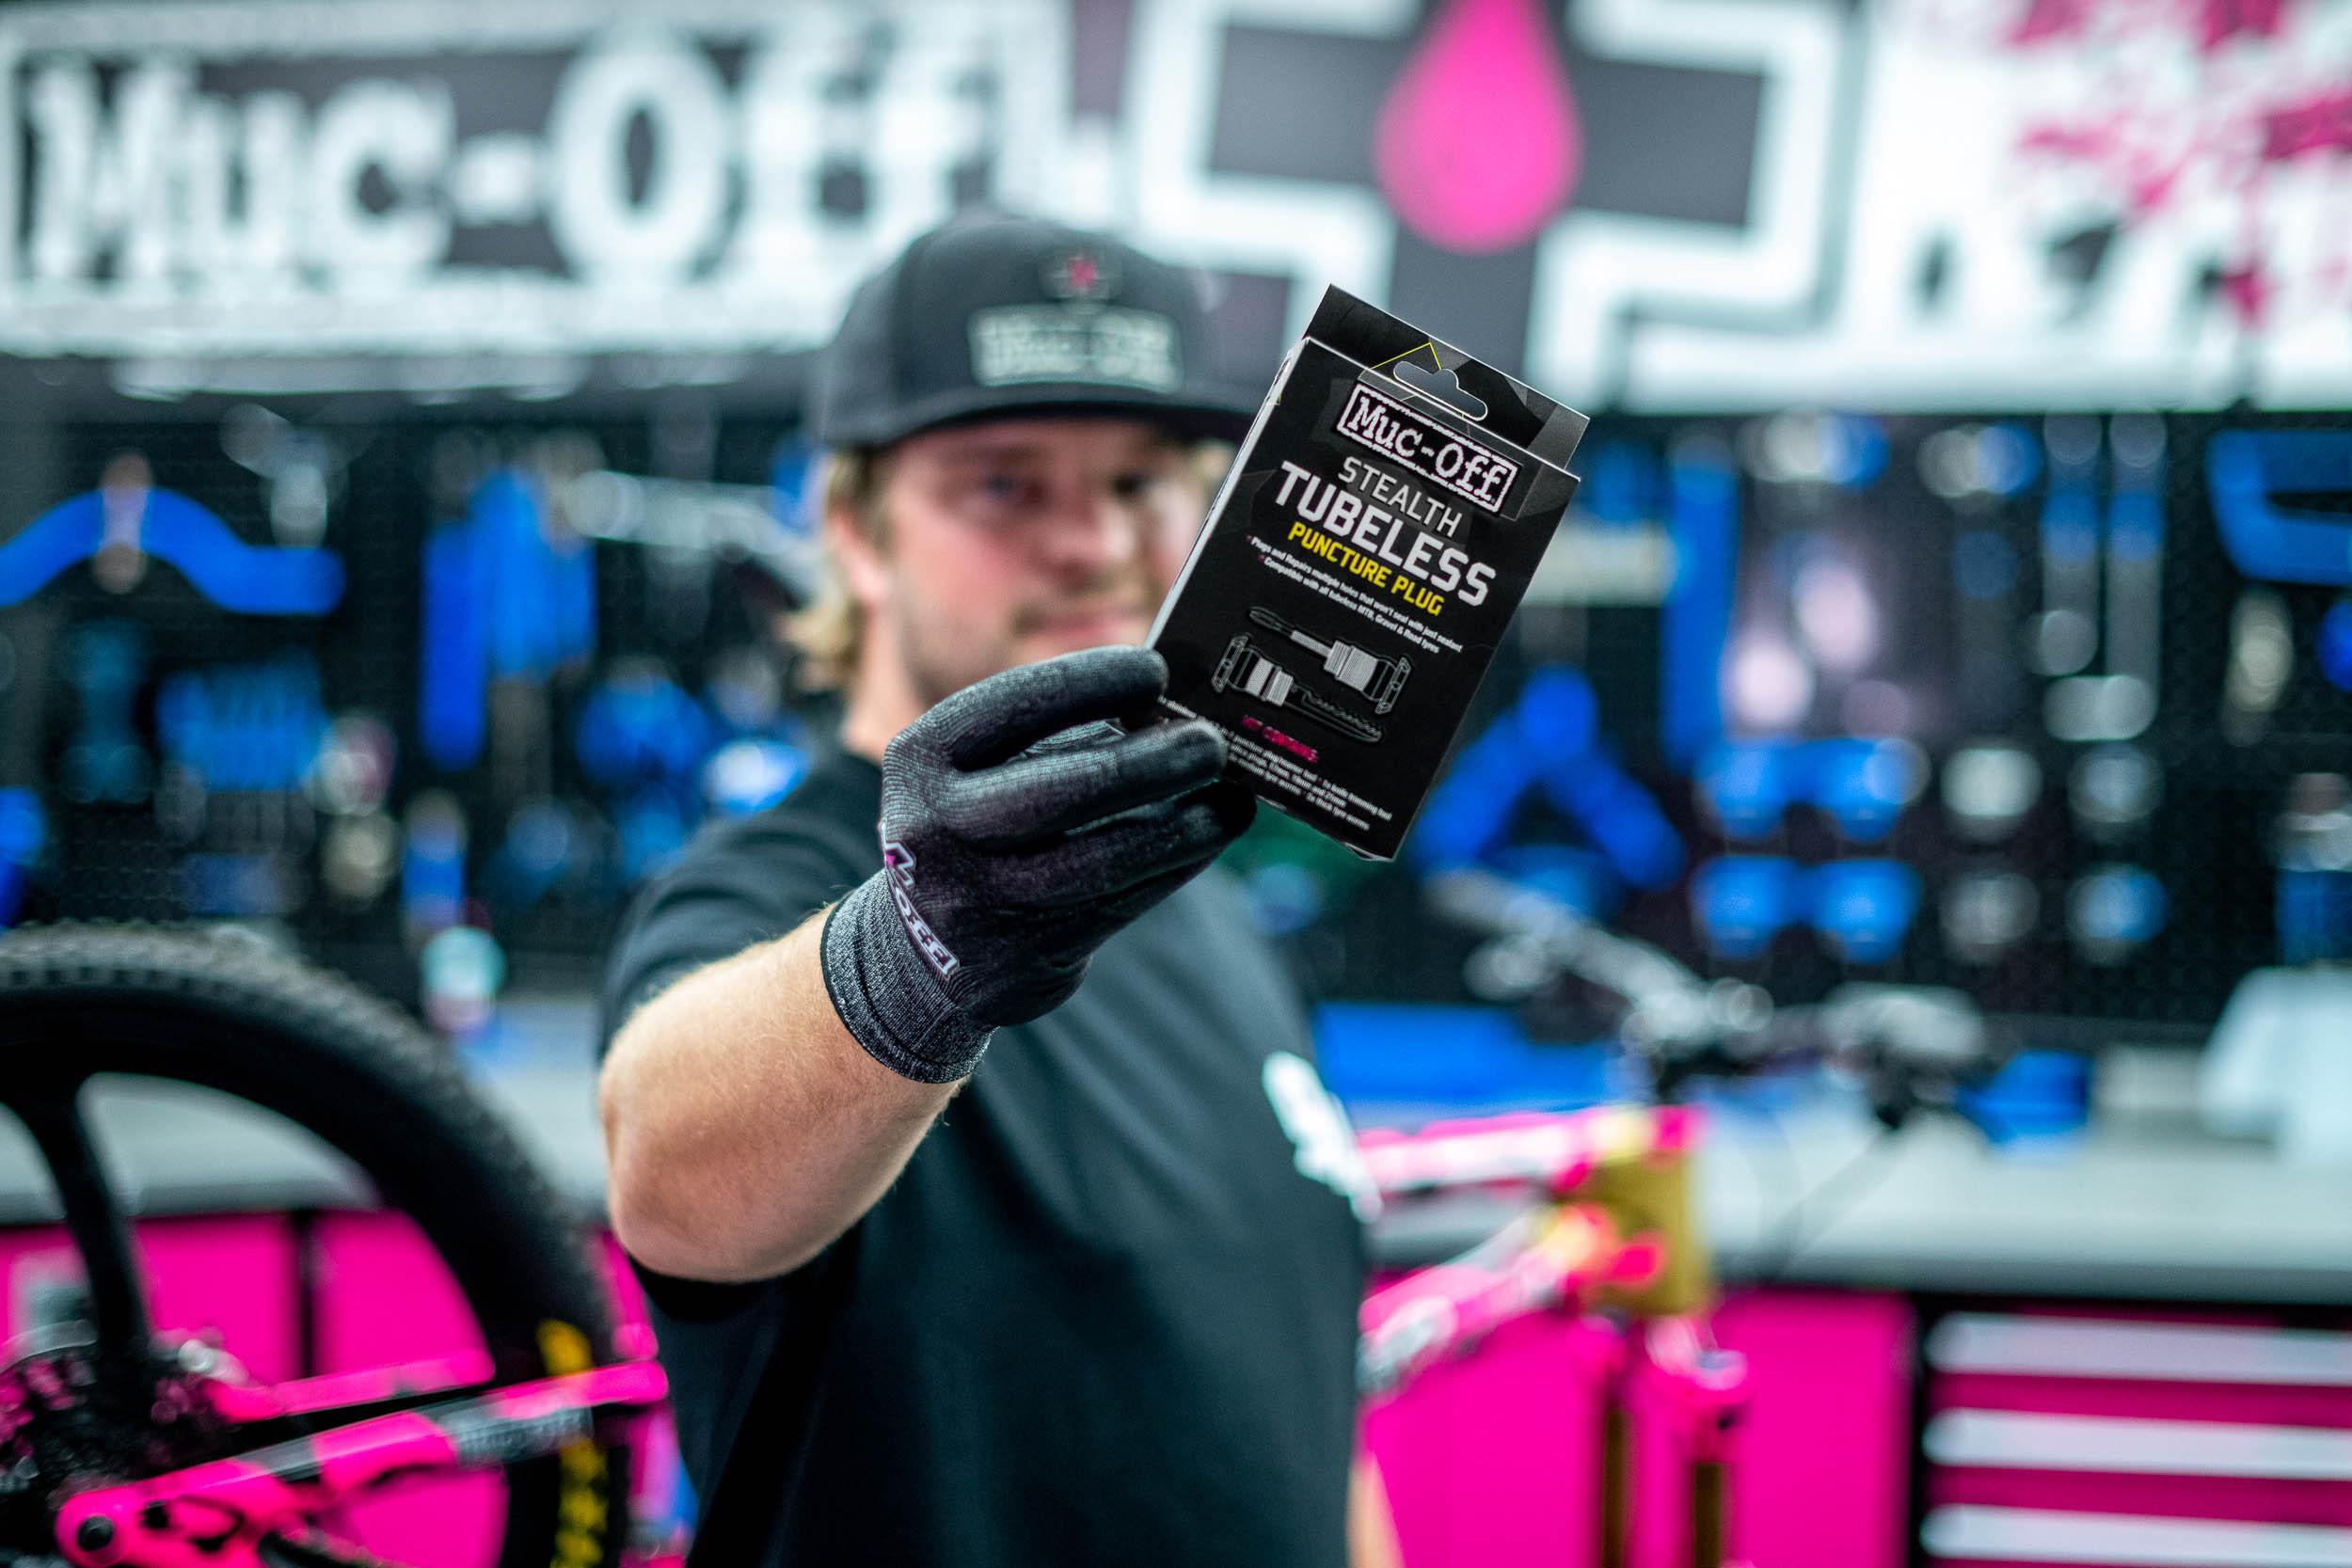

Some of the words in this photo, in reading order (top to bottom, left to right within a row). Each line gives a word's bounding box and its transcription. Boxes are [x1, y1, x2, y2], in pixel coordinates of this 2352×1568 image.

[1339, 457, 1462, 537] STEALTH
[1346, 397, 1509, 500] Muc-Off
[1276, 461, 1496, 606] TUBELESS
[1288, 522, 1391, 587] PUNCTURE
[1391, 576, 1444, 615] PLUG
[1251, 537, 1272, 553] Plugs
[1271, 548, 1286, 560] and
[1285, 554, 1311, 574] Repairs
[1311, 569, 1340, 588] multiple
[1340, 582, 1359, 597] holes
[1359, 593, 1375, 606] that
[1374, 601, 1393, 616] won't
[1392, 612, 1408, 624] seal
[1408, 620, 1423, 634] with
[1422, 626, 1438, 640] just
[1437, 635, 1463, 652] sealant
[1264, 557, 1303, 582] Compatible
[1303, 578, 1319, 590] with
[1318, 586, 1330, 594] all
[1328, 590, 1358, 610] tubeless
[1358, 605, 1375, 621] MTB,
[1375, 614, 1398, 631] Gravel
[1396, 626, 1404, 635] &
[1404, 629, 1424, 643] Road
[1422, 639, 1439, 653] tyres
